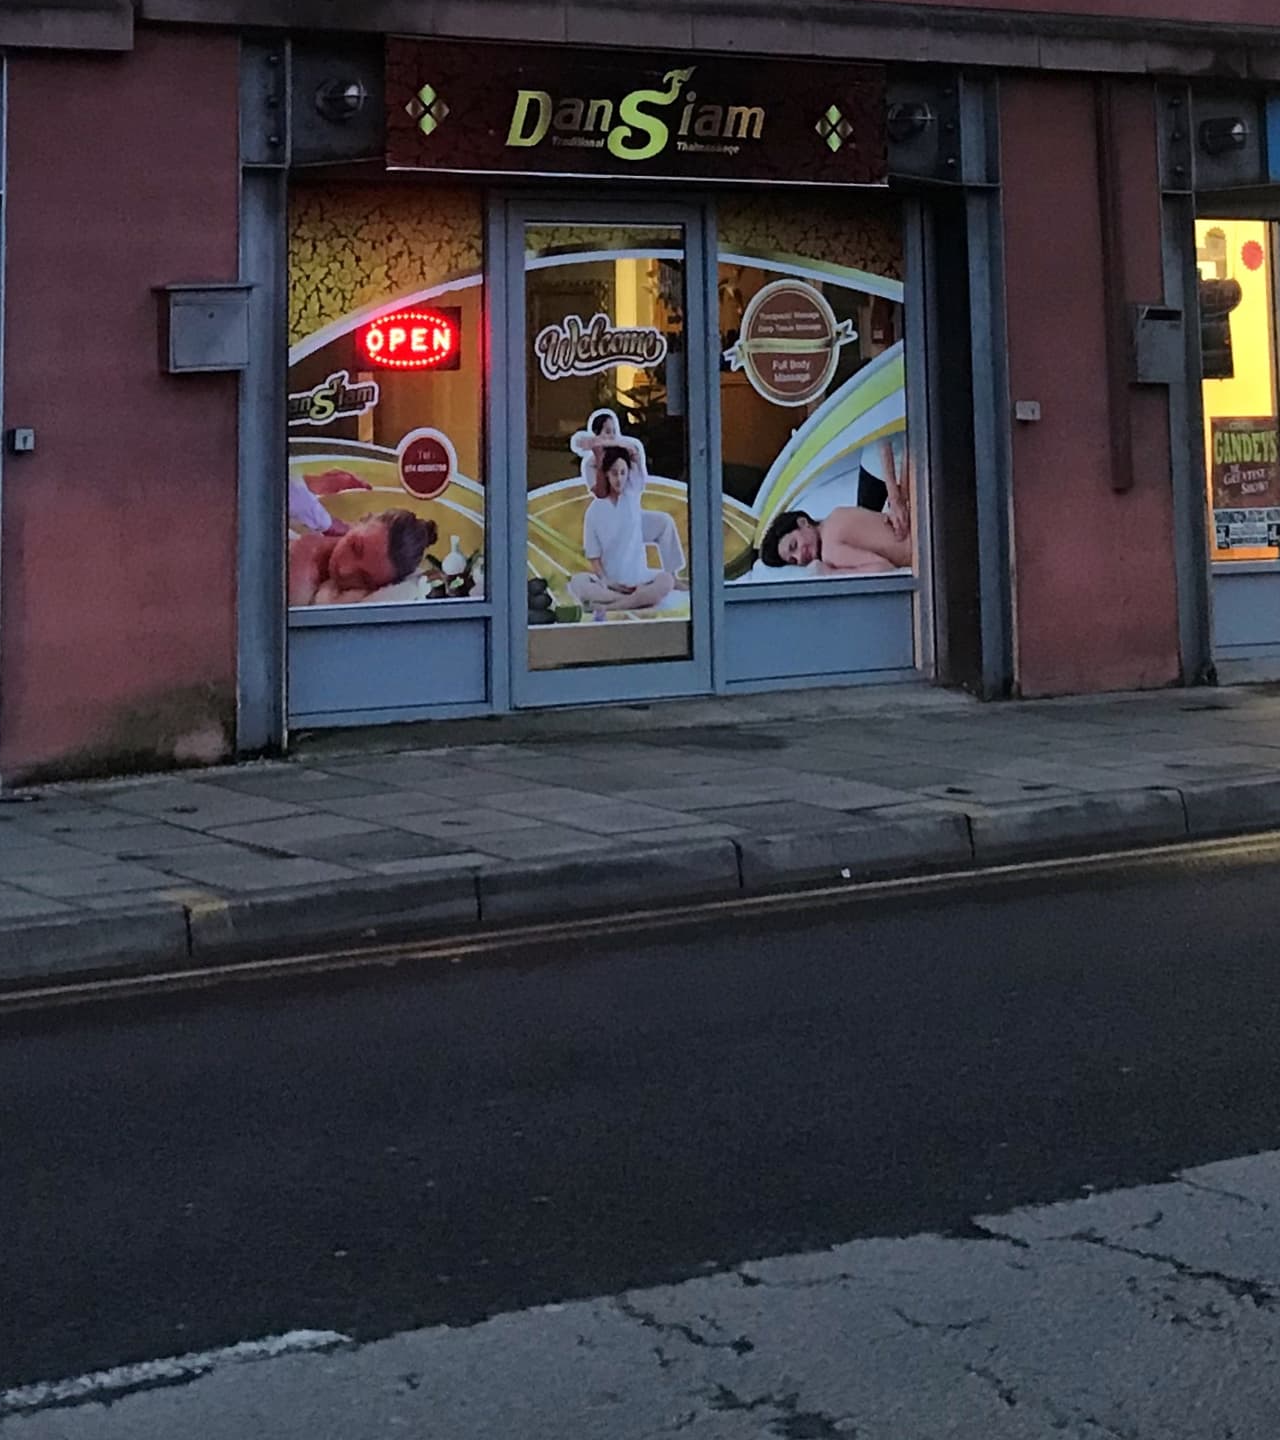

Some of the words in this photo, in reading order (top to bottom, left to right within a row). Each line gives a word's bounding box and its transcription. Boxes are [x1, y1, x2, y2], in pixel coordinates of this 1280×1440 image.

[365, 327, 452, 352] OPEN
[539, 318, 662, 373] Welcome
[1214, 431, 1279, 464] GANDEYS
